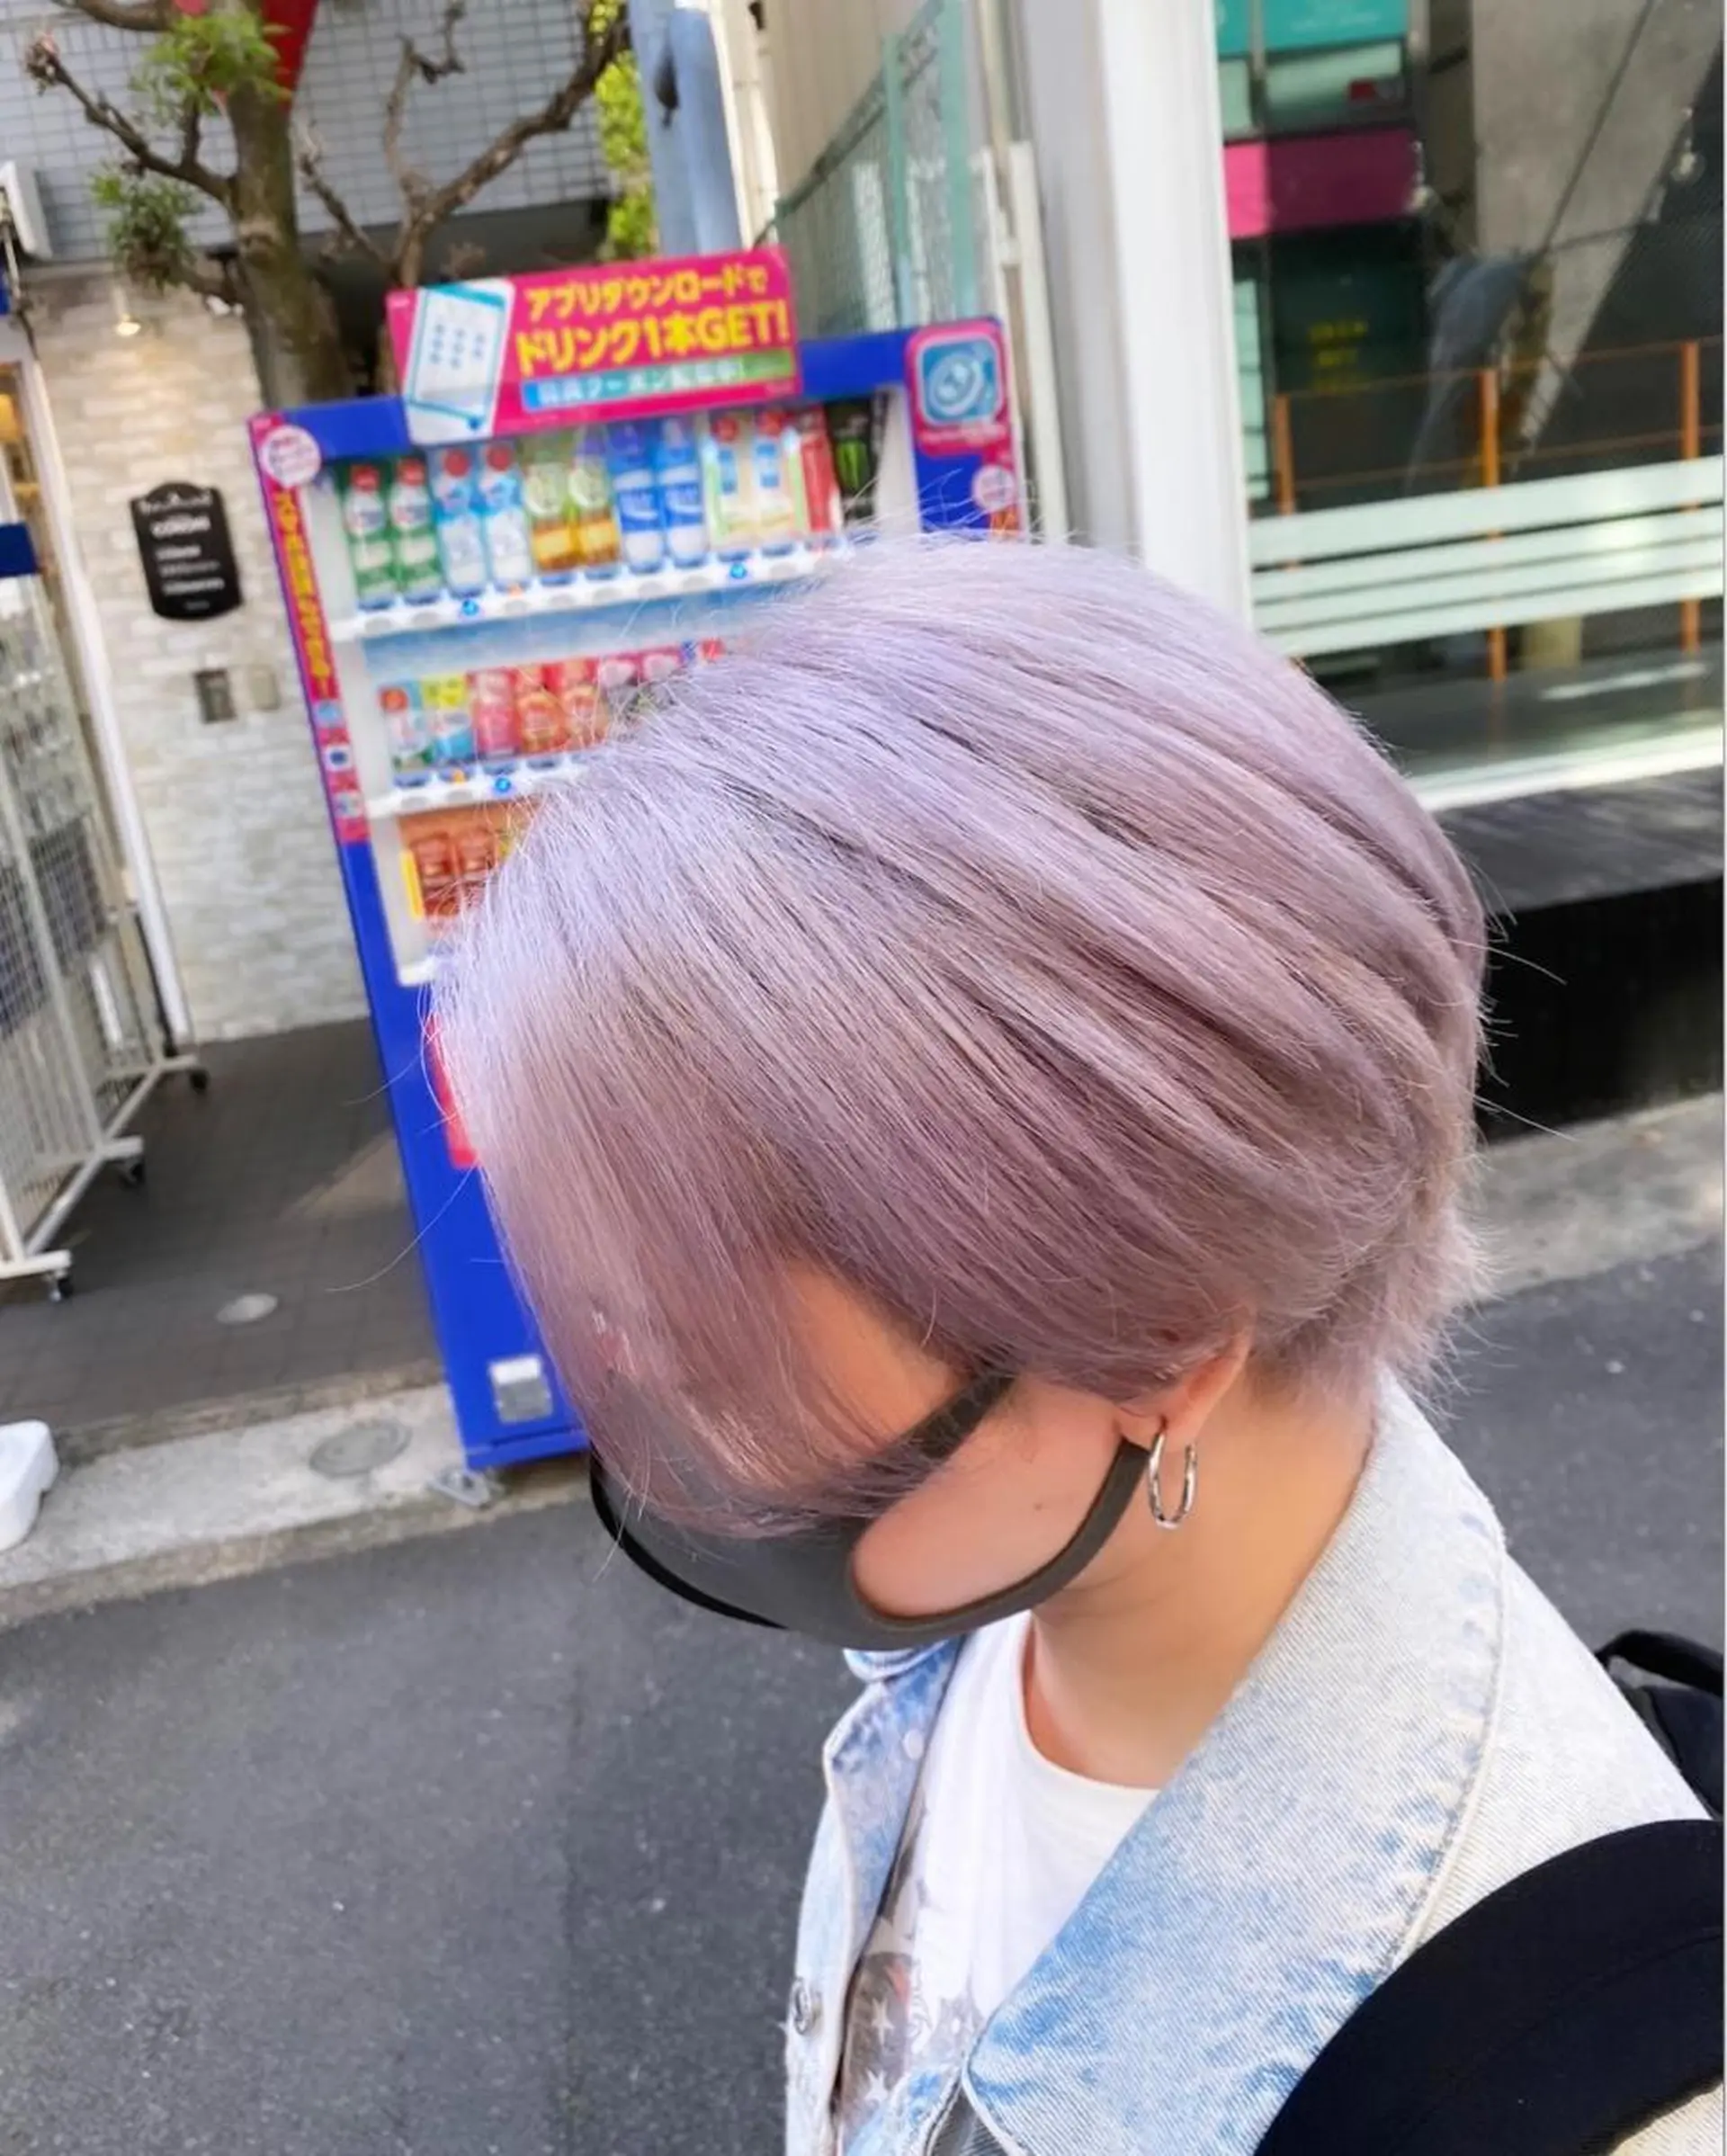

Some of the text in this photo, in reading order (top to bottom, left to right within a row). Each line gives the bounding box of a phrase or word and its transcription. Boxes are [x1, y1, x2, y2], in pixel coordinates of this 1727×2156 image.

[523, 264, 768, 322] アプリダウンロードで
